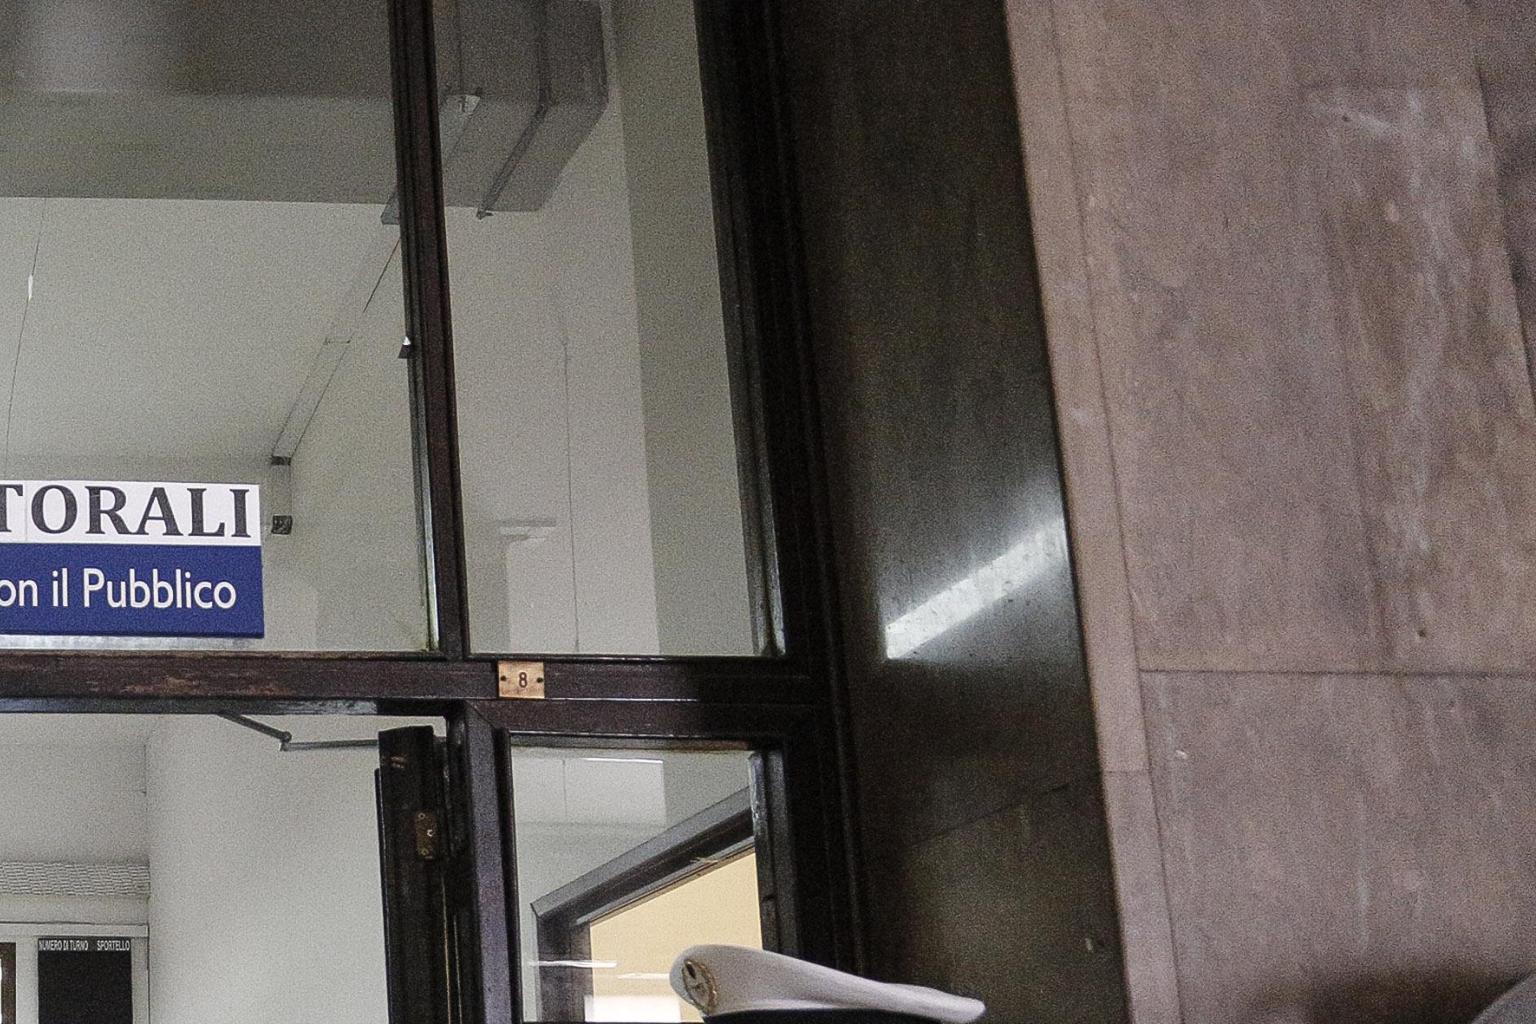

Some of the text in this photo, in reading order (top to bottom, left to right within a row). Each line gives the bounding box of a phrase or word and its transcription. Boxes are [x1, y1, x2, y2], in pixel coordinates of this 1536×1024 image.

[52, 566, 69, 607] il
[83, 566, 237, 609] Pubblico
[519, 672, 528, 688] 8
[38, 940, 62, 951] NUMERO
[69, 940, 89, 951] TURNO
[97, 940, 130, 951] SPORTELLO
